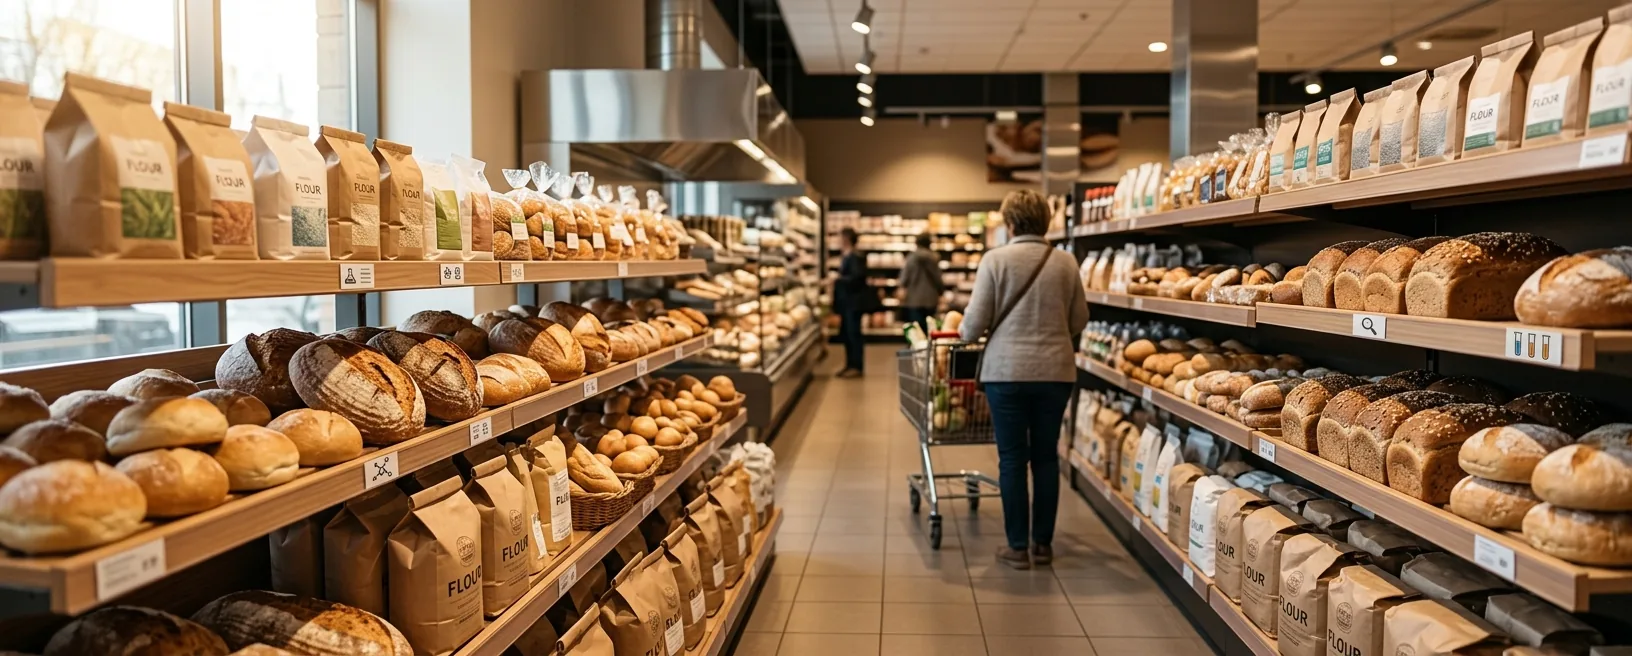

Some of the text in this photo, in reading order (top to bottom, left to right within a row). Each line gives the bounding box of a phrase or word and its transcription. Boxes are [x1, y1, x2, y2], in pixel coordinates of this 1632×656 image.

[1469, 108, 1494, 121] FLOUR
[0, 158, 35, 174] OUR
[295, 182, 322, 195] FLOUR
[1243, 561, 1266, 587] LOUR
[1279, 595, 1308, 627] FLOUR
[1328, 628, 1362, 656] FLOUR
